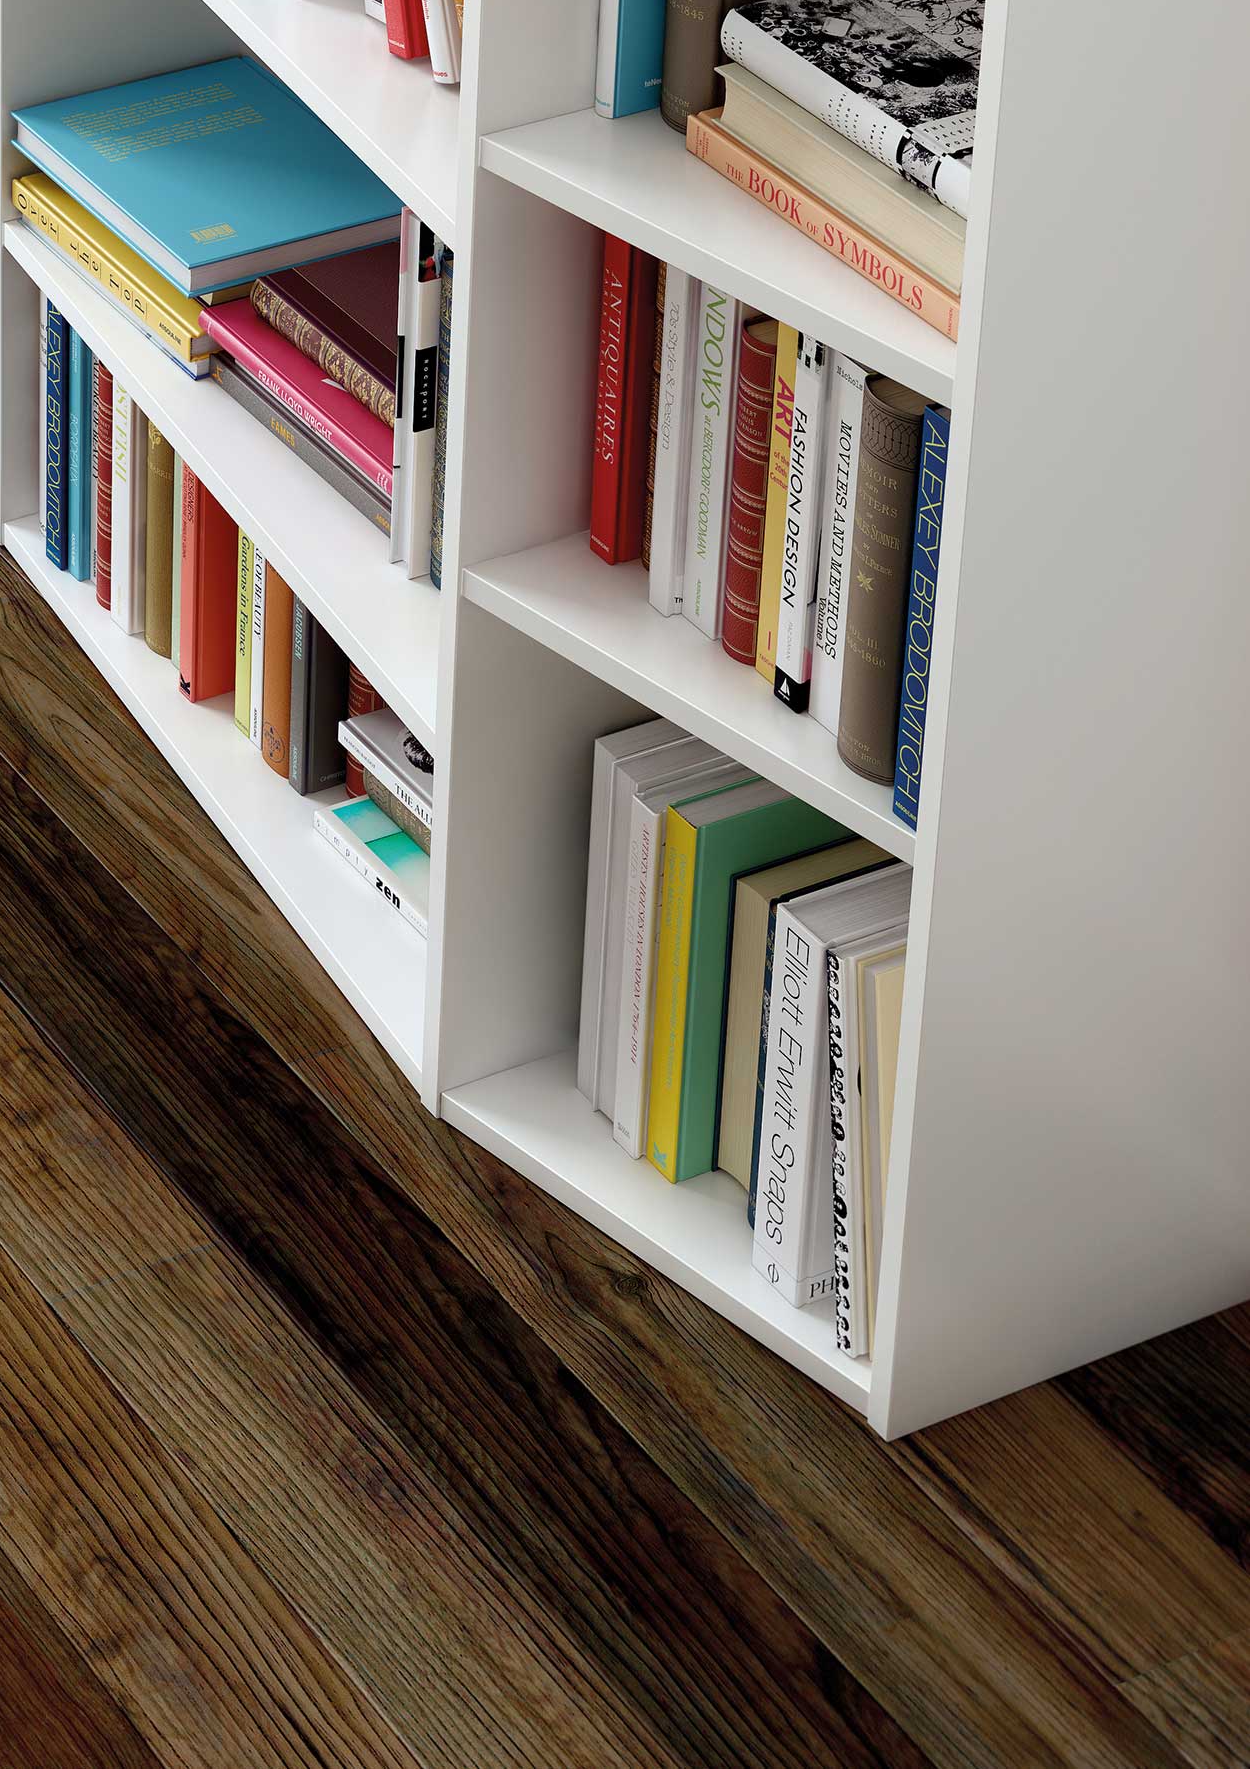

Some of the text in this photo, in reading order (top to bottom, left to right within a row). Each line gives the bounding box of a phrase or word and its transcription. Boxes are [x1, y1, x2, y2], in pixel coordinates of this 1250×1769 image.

[16, 192, 58, 235] Over
[109, 276, 147, 316] Top
[725, 160, 924, 311] THE BOOK OF SYMBOLS
[158, 321, 183, 345] ASSOULINE
[601, 271, 623, 466] ANTIQUAIRES
[666, 328, 680, 373] Style
[257, 370, 333, 441] FRANK LLOYD WRIGHT
[667, 373, 677, 388] &
[774, 375, 795, 448] ART
[47, 301, 61, 549] ALEXEY BRODOVITCH
[270, 417, 296, 447] EAMES
[661, 390, 674, 451] Design
[701, 429, 715, 493] BERGDORF
[696, 493, 711, 560] GOODMAN
[781, 406, 808, 608] FASHION DESIGN
[823, 419, 853, 660] MOVIES AND METHODS
[239, 534, 251, 657] Gardens in France
[253, 560, 263, 641] OF BEAUTY
[817, 595, 828, 640] Volume
[897, 420, 946, 803] ALEXEY BRODOVITCH
[294, 604, 303, 660] JACOBSEN
[394, 781, 414, 811] THE
[375, 876, 401, 910] zen
[763, 927, 810, 1245] Elliott Erwitt Snaps
